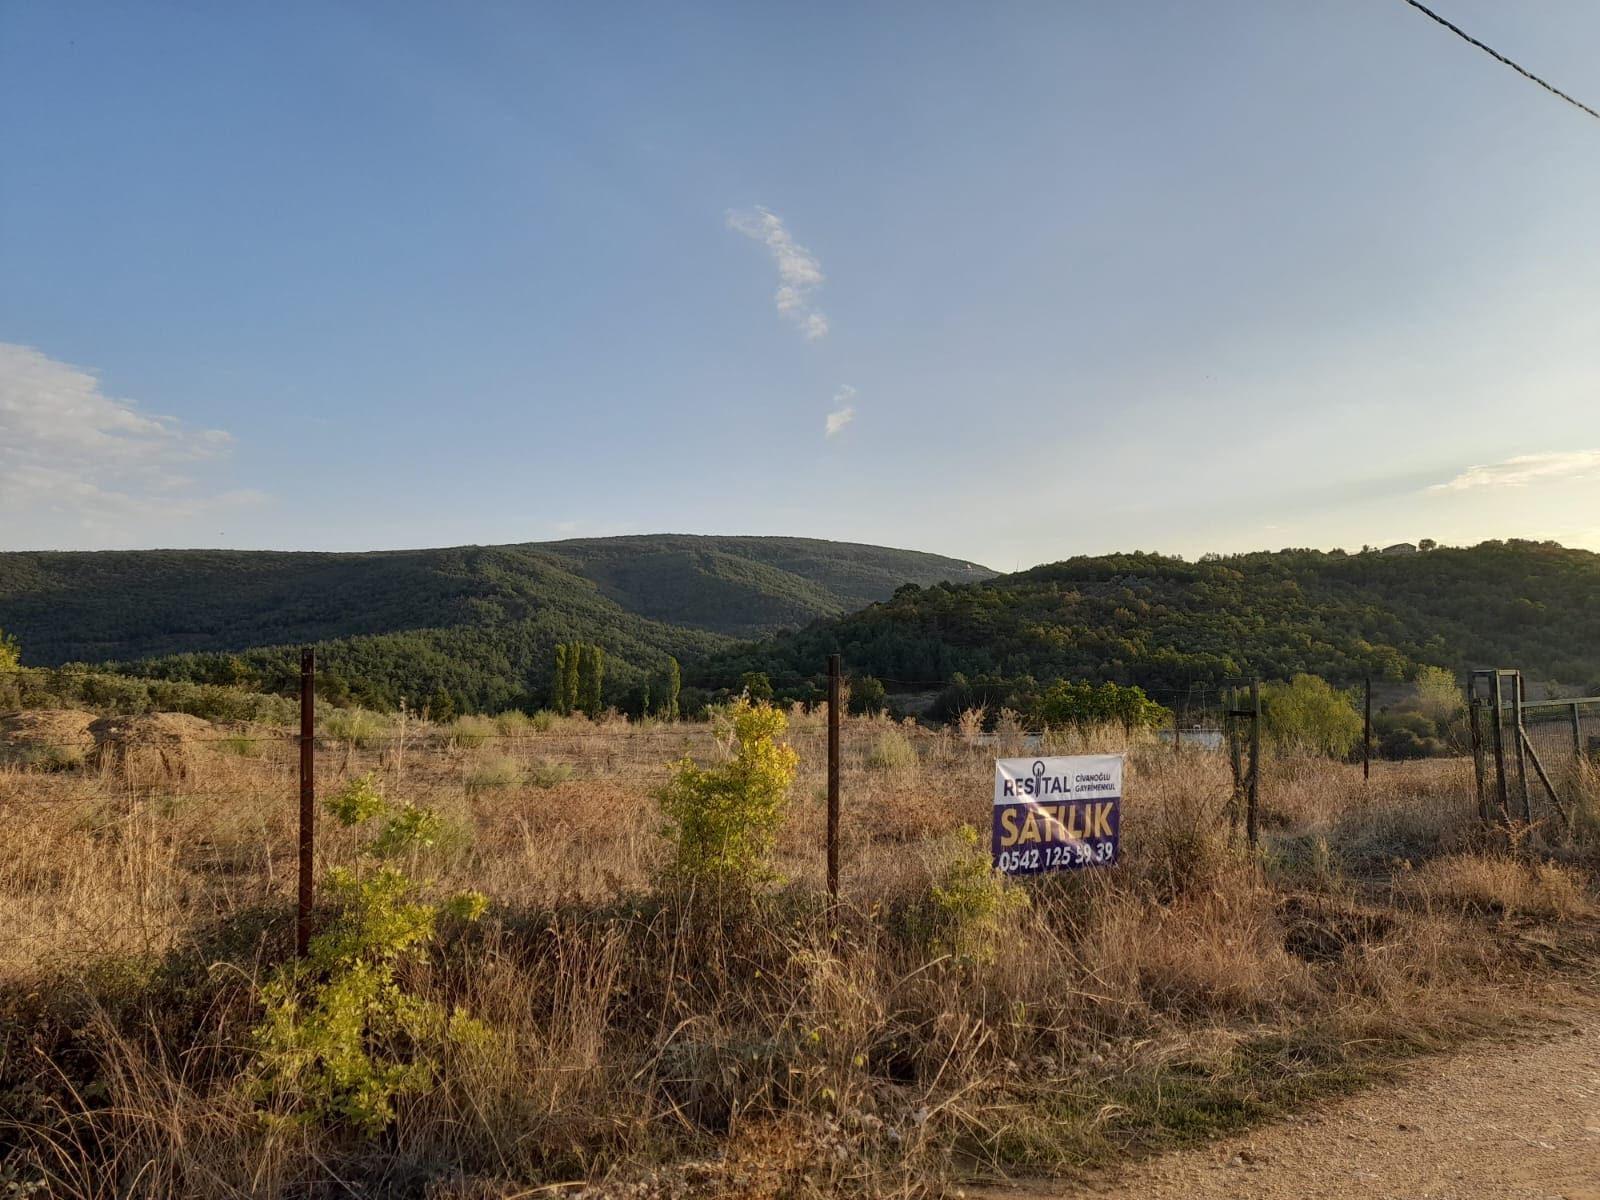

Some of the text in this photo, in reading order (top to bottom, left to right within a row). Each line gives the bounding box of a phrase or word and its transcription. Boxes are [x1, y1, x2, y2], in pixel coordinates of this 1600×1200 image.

[1000, 802, 1114, 847] SATILIK
[1000, 849, 1040, 872] 0542
[1045, 846, 1071, 866] 125
[1096, 842, 1113, 862] 39
